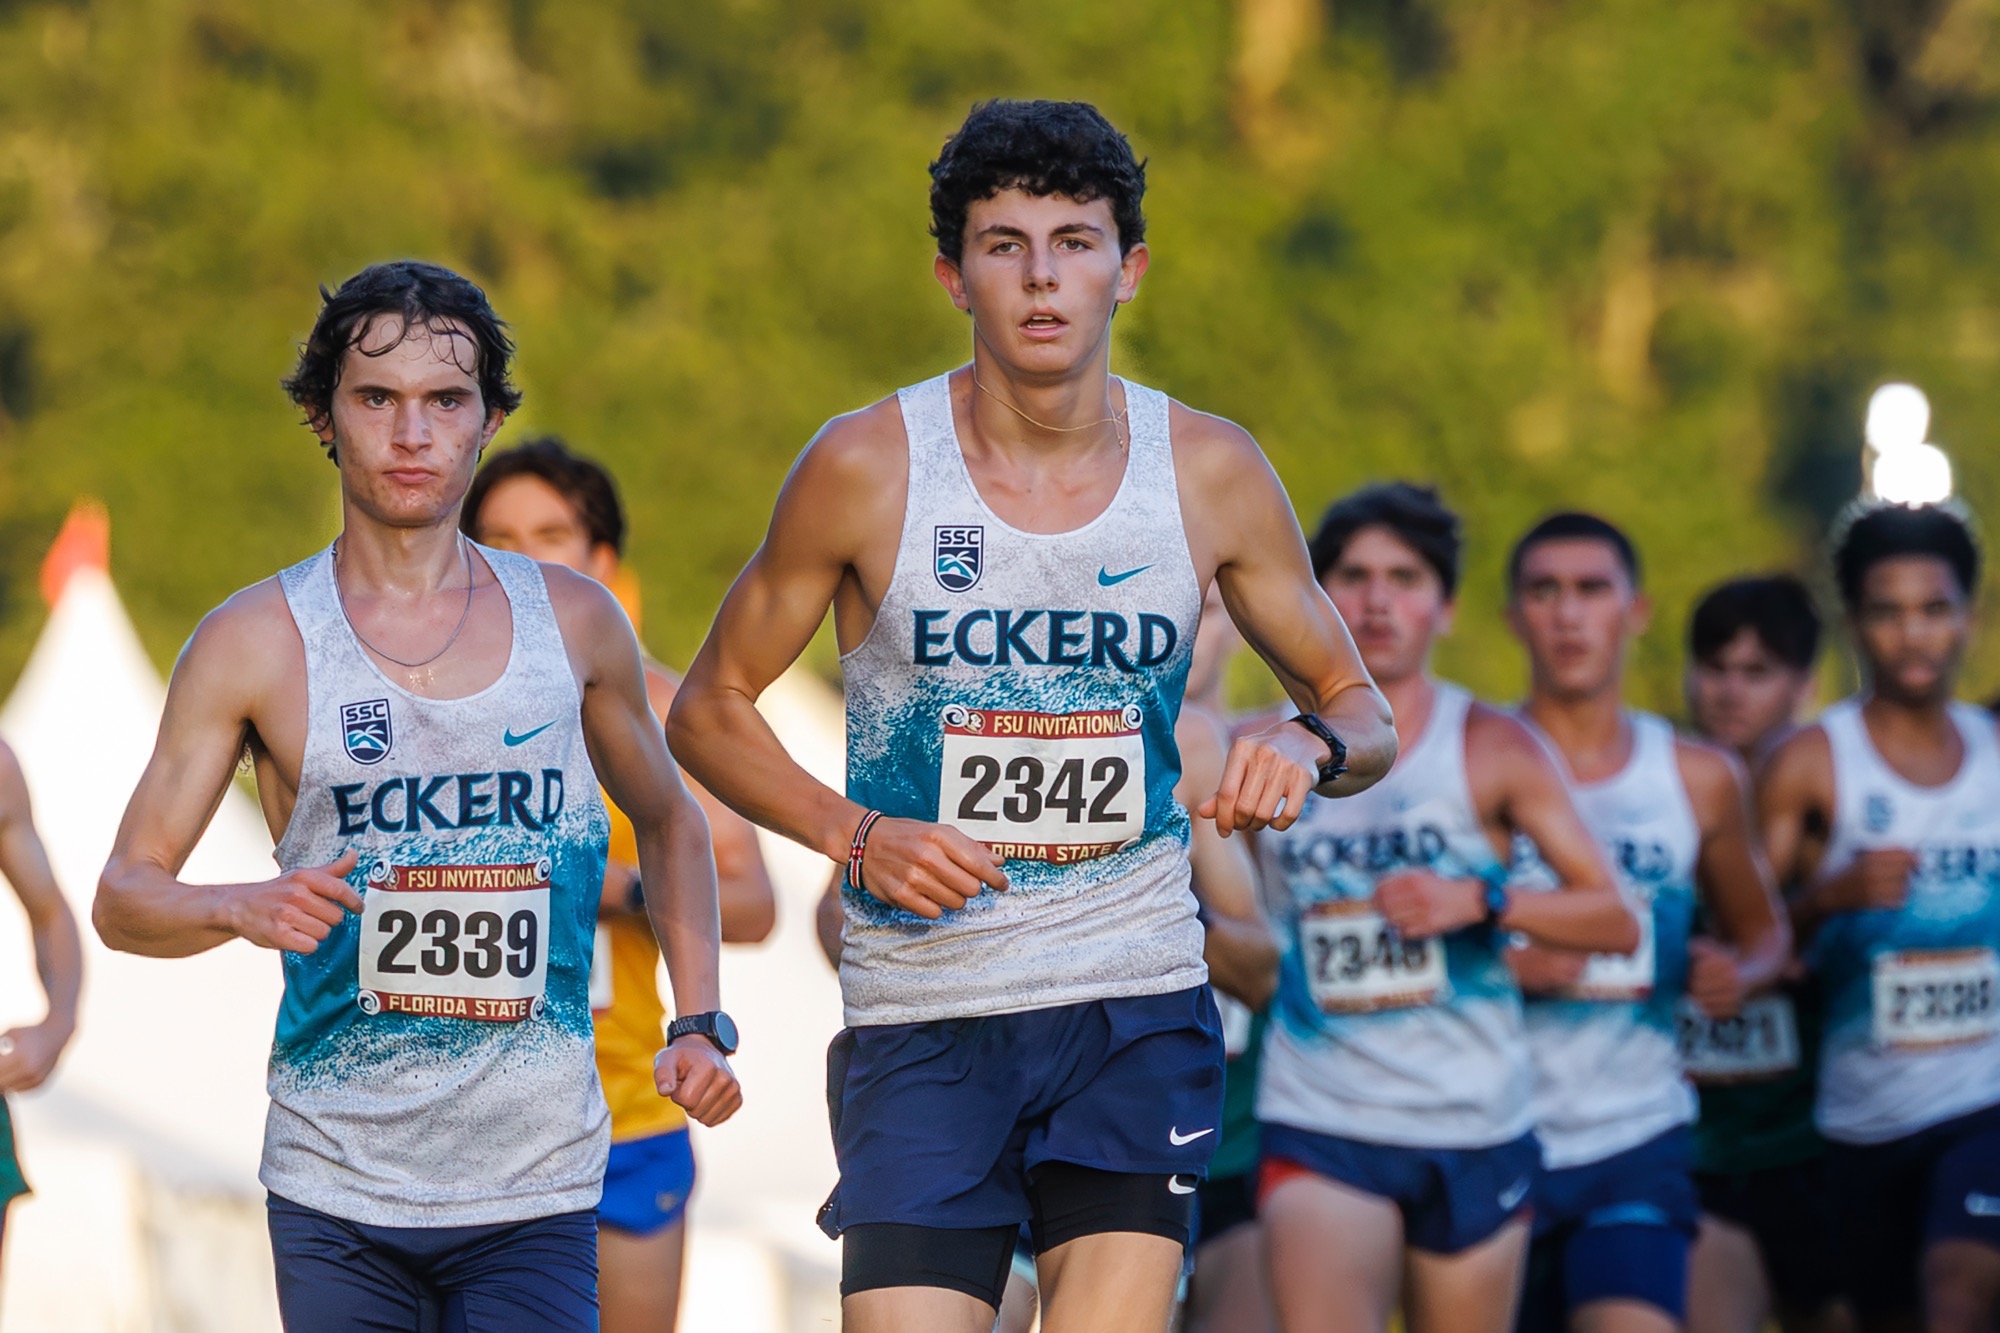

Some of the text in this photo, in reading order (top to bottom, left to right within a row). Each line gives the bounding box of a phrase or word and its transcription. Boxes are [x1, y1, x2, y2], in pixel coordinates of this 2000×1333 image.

[939, 530, 980, 545] SSC
[911, 608, 1178, 673] ECKERD
[345, 703, 386, 723] SSC
[993, 714, 1128, 735] FSU INVITATIONAL
[957, 754, 1130, 824] 2342
[331, 768, 565, 836] ECKERD
[990, 843, 1112, 862] ORIDA STATE
[408, 868, 539, 889] FSU INVITATIONAL
[376, 908, 539, 979] 2339
[389, 995, 527, 1017] FLORIDA STATE
